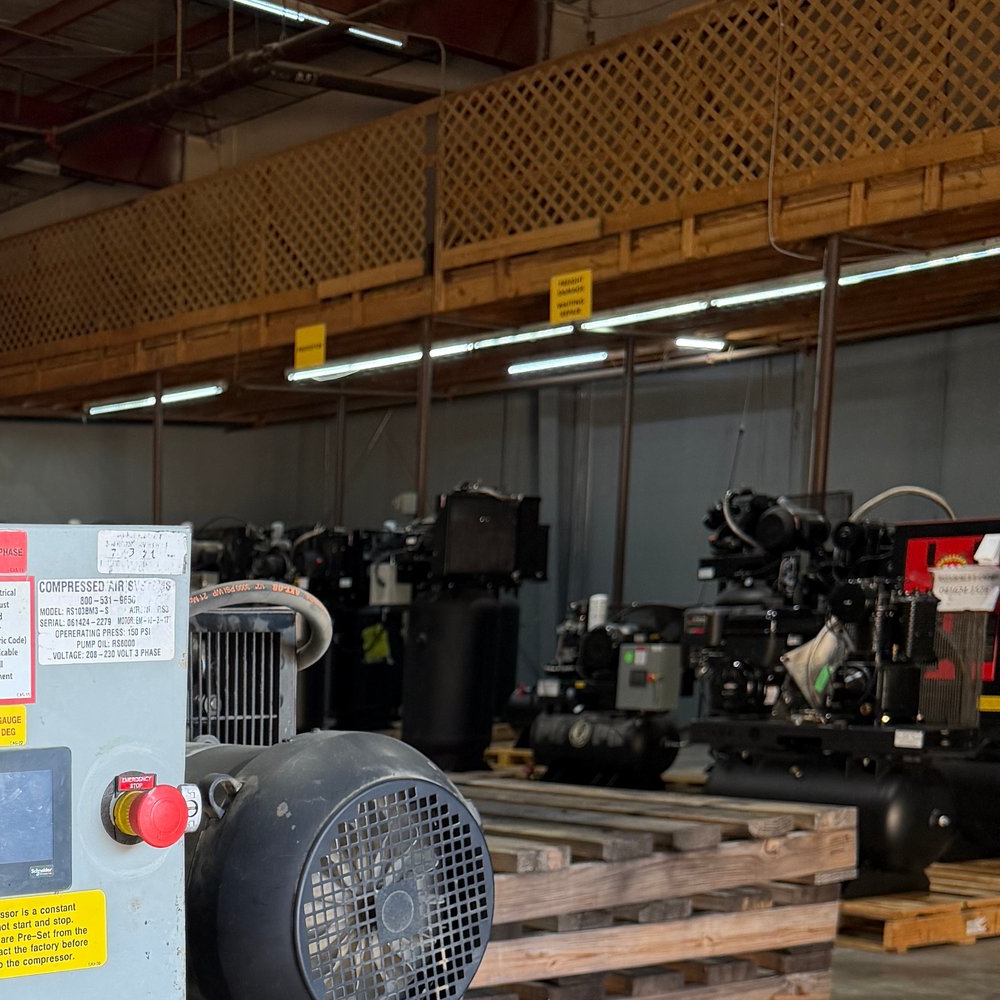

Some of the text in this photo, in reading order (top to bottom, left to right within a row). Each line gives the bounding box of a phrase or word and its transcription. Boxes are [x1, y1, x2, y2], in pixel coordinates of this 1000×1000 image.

[39, 580, 105, 592] COMPRESSED
[128, 628, 138, 636] 150
[140, 628, 151, 636] PSI
[8, 636, 27, 644] Code)
[117, 649, 133, 657] VOLT
[134, 649, 139, 657] 3
[140, 648, 161, 657] PHASE
[1, 728, 16, 736] DEG
[21, 908, 29, 916] is
[40, 903, 76, 914] constant
[12, 920, 32, 930] start
[34, 918, 51, 928] and
[53, 916, 74, 928] stop.
[0, 936, 14, 944] are
[17, 930, 51, 942] Pre-Set
[53, 928, 72, 938] from
[75, 926, 88, 936] the
[14, 944, 27, 954] the
[30, 941, 59, 954] factory
[62, 938, 89, 949] before
[6, 957, 20, 967] the
[22, 954, 75, 968] compressor.
